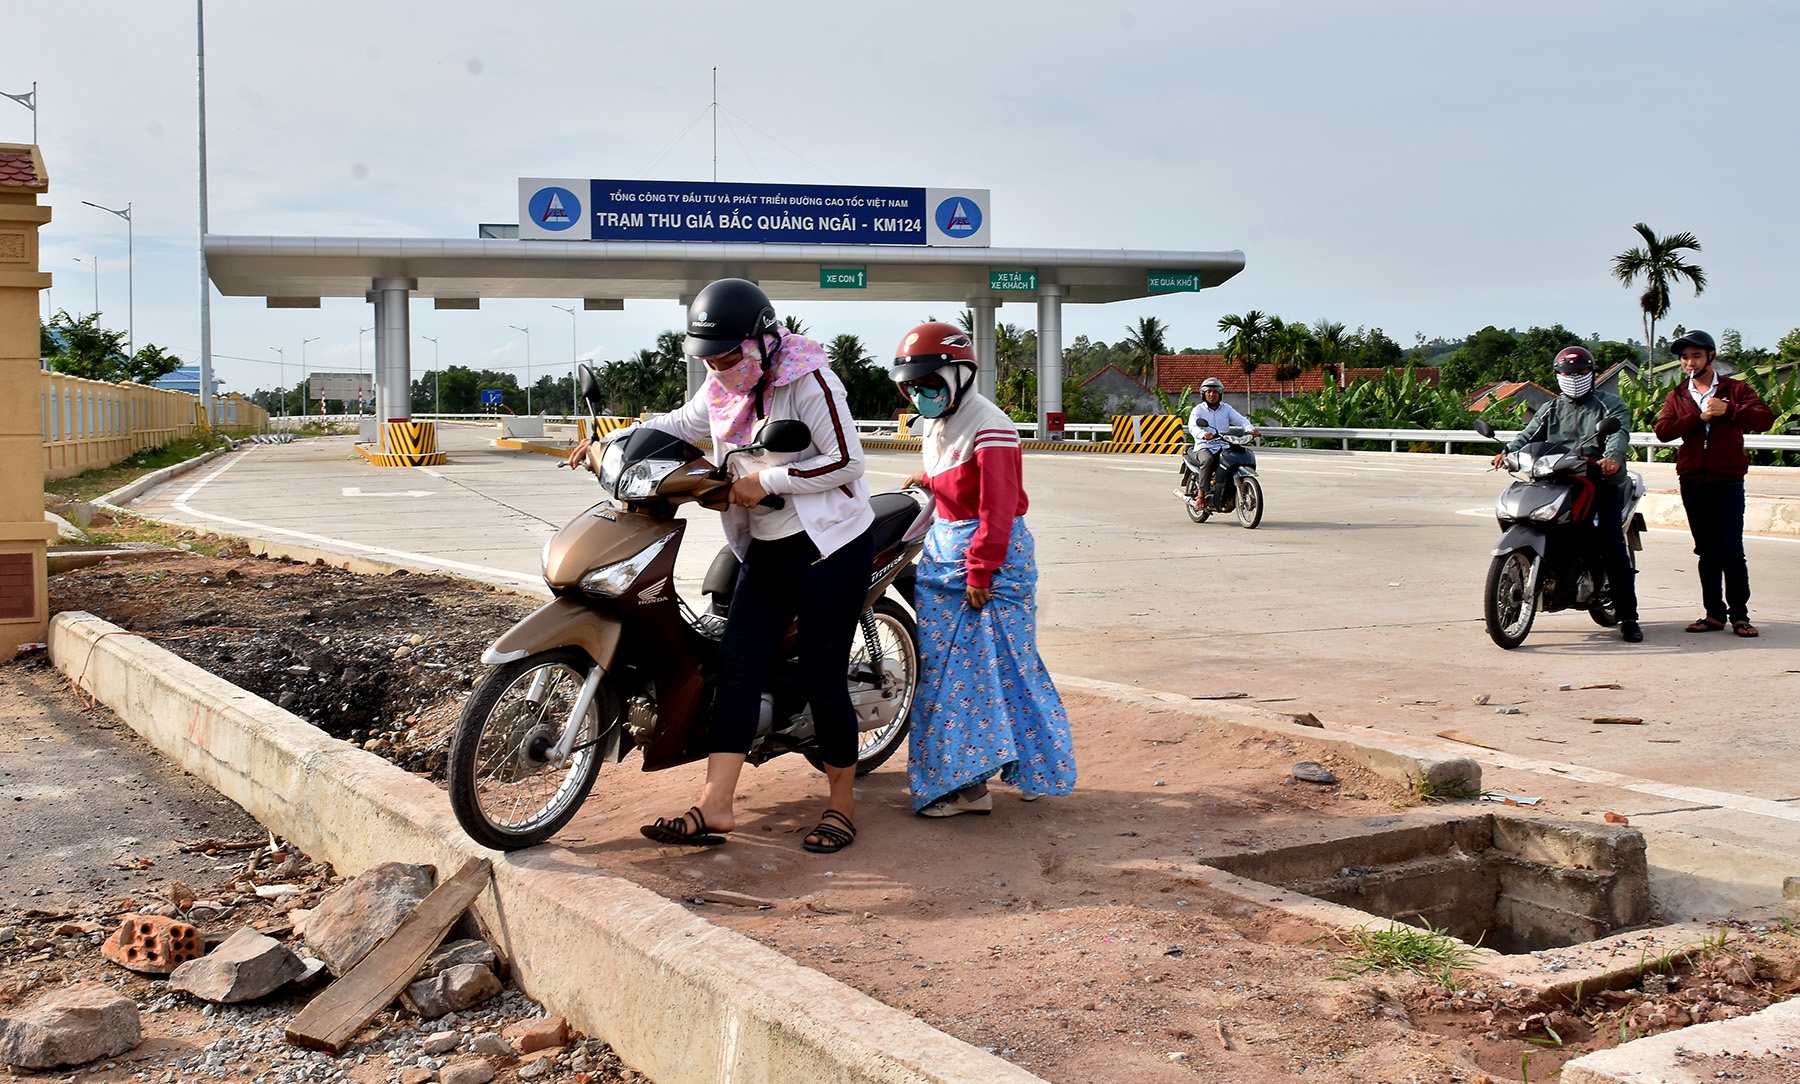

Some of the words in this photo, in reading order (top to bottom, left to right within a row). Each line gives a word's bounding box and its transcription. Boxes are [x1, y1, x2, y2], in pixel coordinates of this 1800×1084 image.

[610, 189, 636, 202] TỔNG
[638, 191, 666, 202] CÔNG
[668, 194, 680, 203] TY
[682, 191, 701, 203] ĐẦU
[704, 194, 717, 203] TƯ
[718, 193, 730, 203] VÀ
[733, 193, 758, 204] PHÁT
[760, 192, 787, 205] TRIỂN
[789, 195, 823, 206] ĐƯỜNG
[825, 198, 845, 206] CAO
[845, 195, 864, 207] TỐC
[866, 197, 886, 208] VIỆT
[888, 200, 908, 208] NAM
[596, 212, 644, 230] TRẠM
[648, 213, 681, 228] THU
[685, 210, 714, 229] GIÁ
[719, 208, 753, 230] BẮC
[757, 210, 814, 231] QUẢNG
[818, 214, 856, 231] NGÃI
[874, 218, 922, 232] KM124
[826, 275, 837, 283] XE
[838, 275, 855, 283] CON
[998, 273, 1008, 281] XE
[1009, 271, 1022, 281] TẢI
[1160, 277, 1175, 286] QUÁ
[1176, 275, 1192, 286] KHỔ
[991, 281, 1001, 290] XE
[1002, 281, 1028, 290] KHÁCH
[638, 596, 668, 605] HONDA
